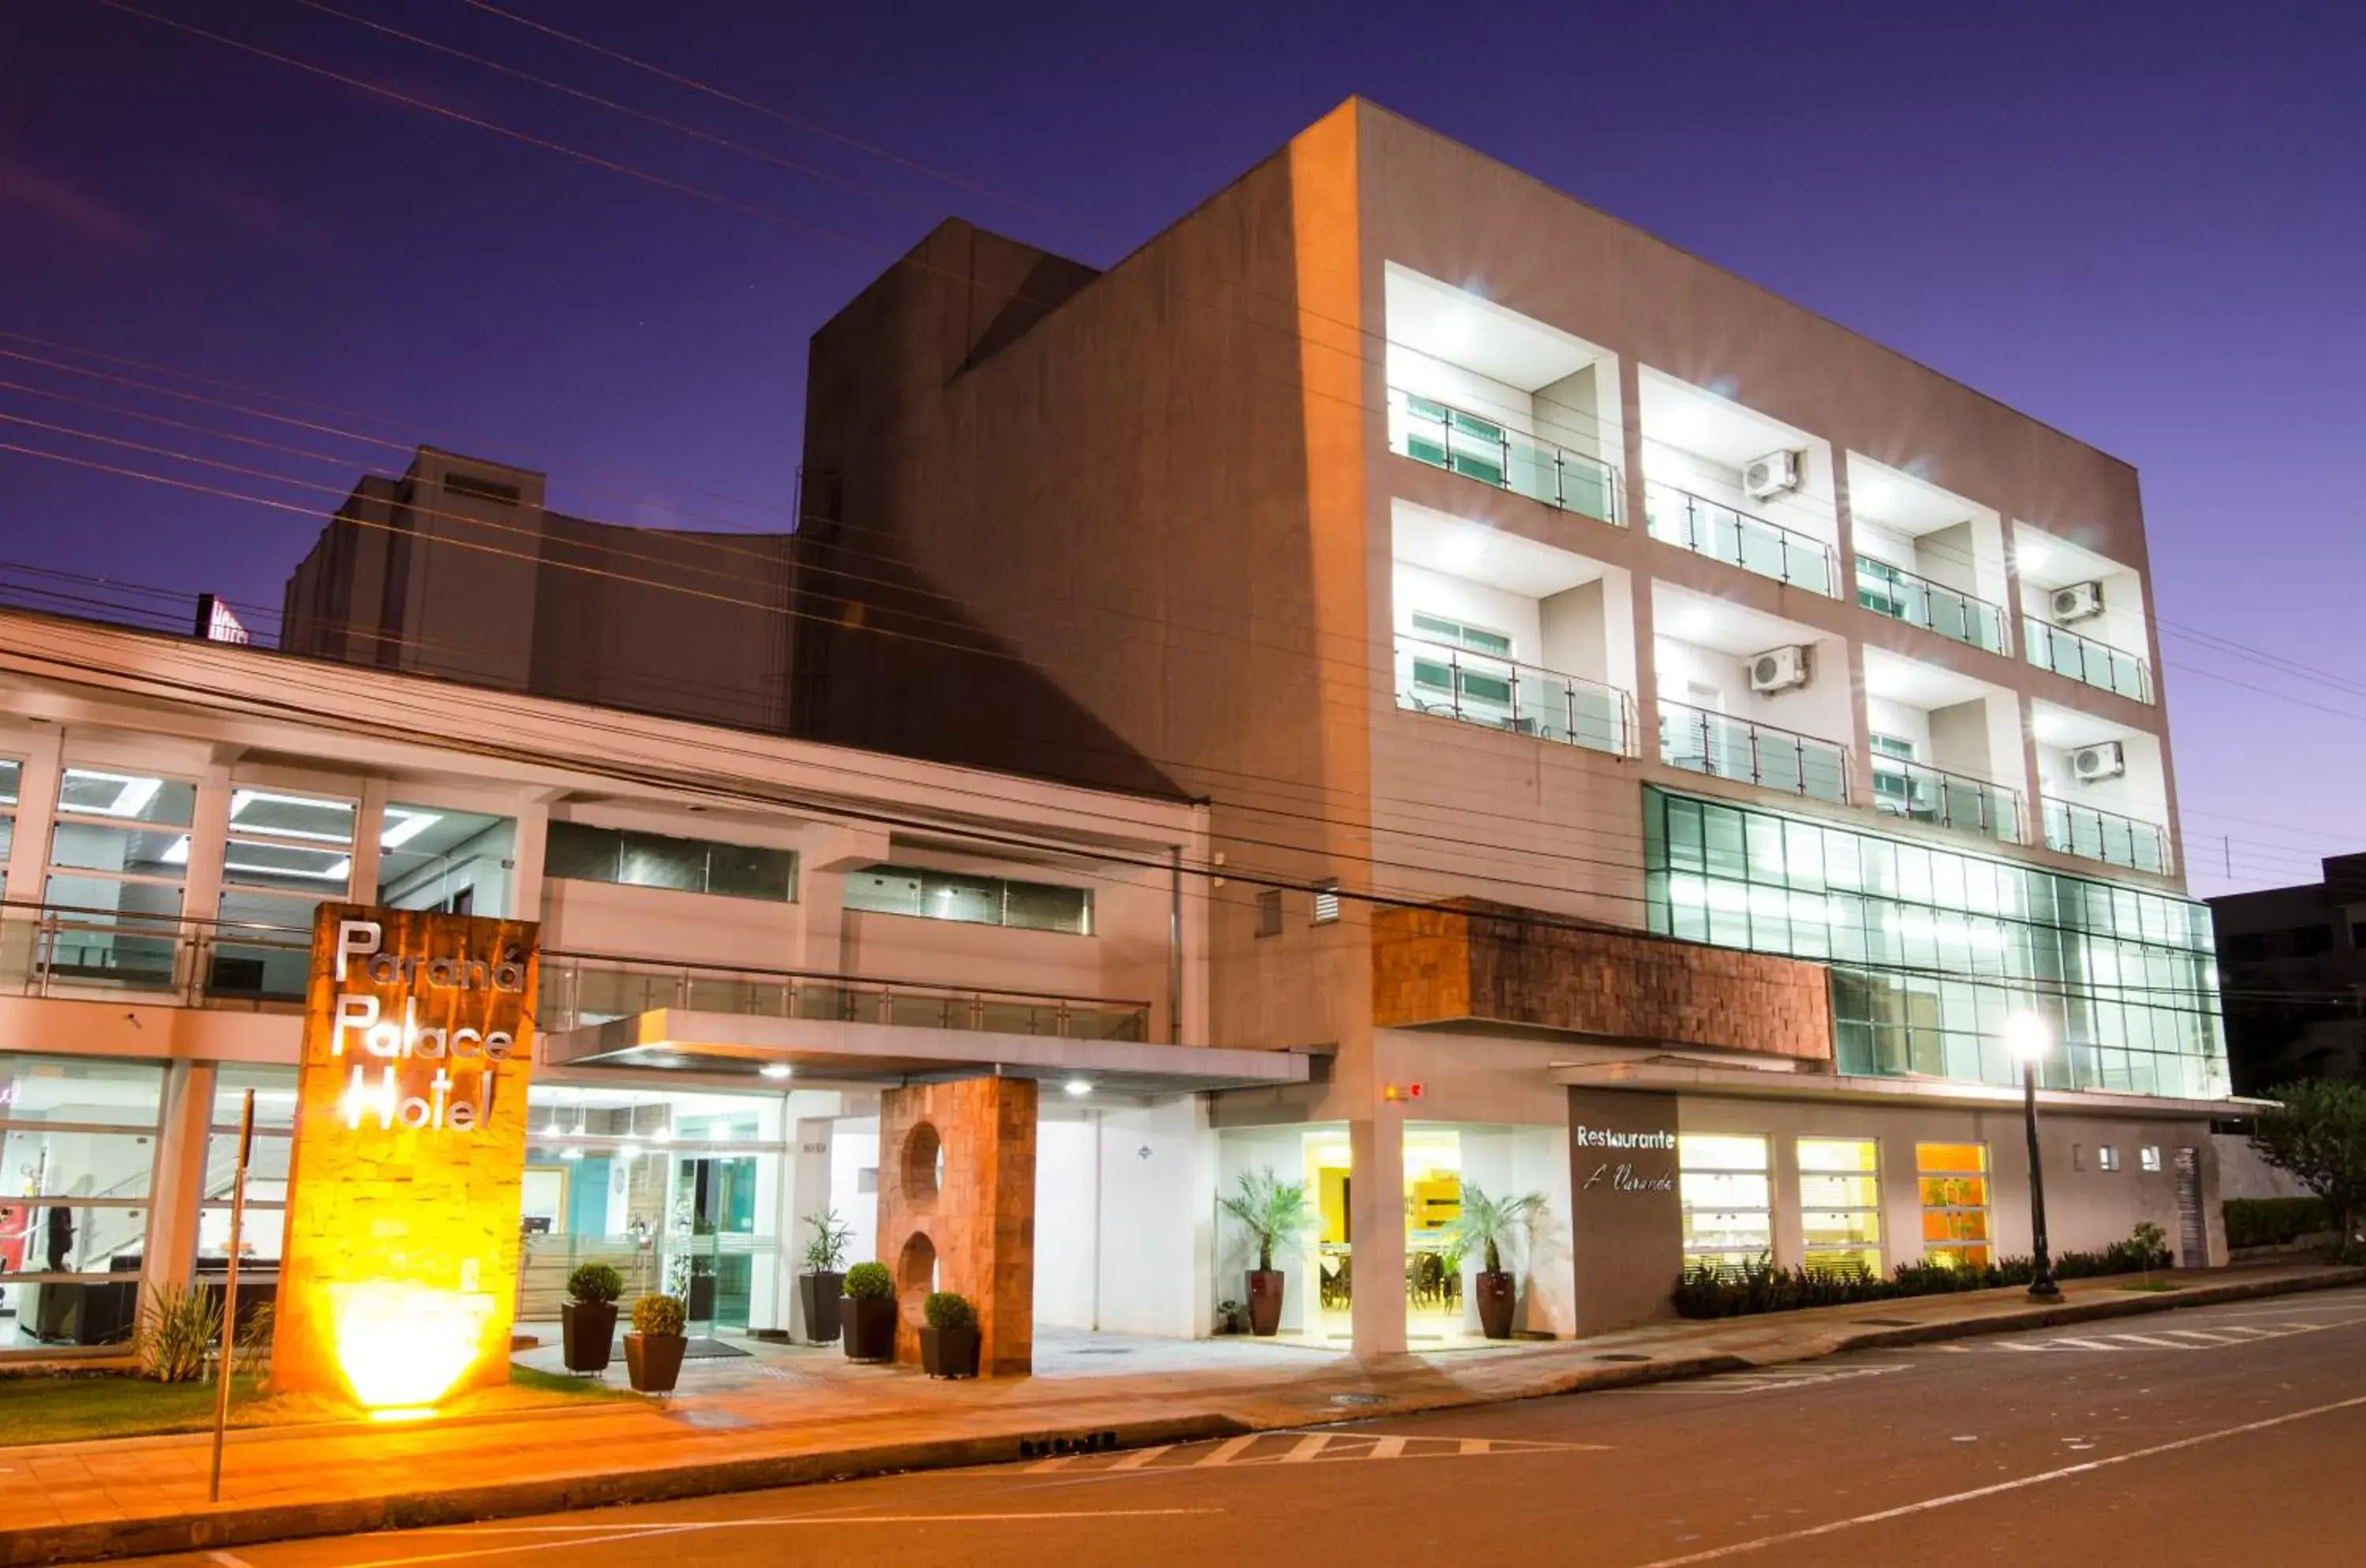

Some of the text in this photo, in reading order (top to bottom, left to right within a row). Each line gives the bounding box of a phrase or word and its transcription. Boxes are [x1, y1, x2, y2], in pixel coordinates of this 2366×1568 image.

[335, 920, 524, 993] Paraná
[331, 994, 513, 1061] Palace
[345, 1065, 494, 1131] Hotel
[1577, 1126, 1675, 1149] Restaurante
